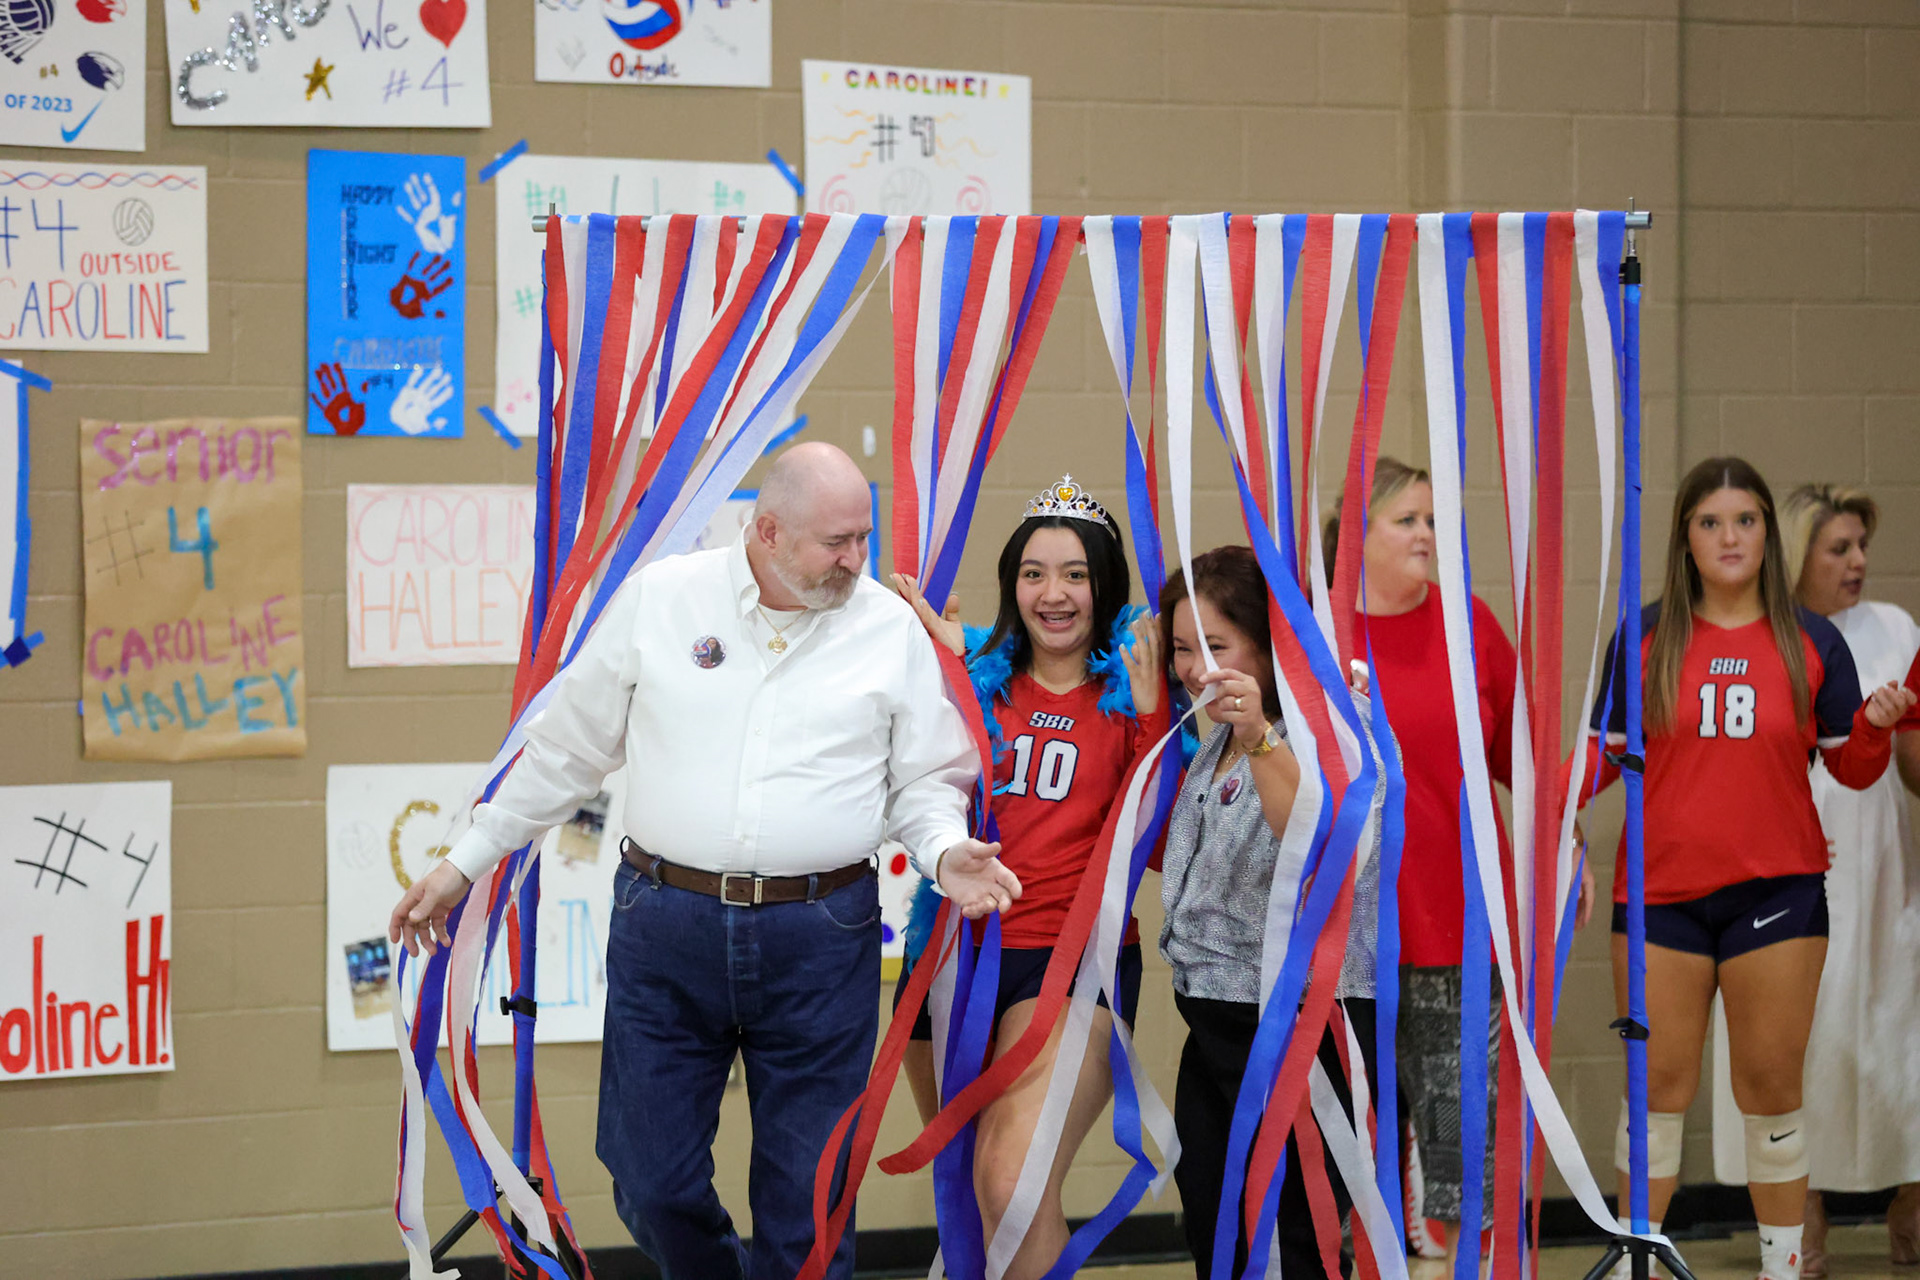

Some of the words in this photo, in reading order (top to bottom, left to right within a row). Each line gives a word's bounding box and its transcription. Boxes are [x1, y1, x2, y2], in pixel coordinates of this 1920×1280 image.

[347, 0, 408, 51] We
[4, 94, 27, 109] OF
[31, 95, 73, 113] 2023
[382, 55, 464, 106] #4
[845, 69, 989, 97] CAROLINE!
[80, 251, 181, 278] OUTSIDE
[355, 493, 536, 567] CAROLIN
[358, 565, 535, 653] HALLEY
[1708, 657, 1750, 676] SBA
[101, 667, 299, 737] HALLEY
[1028, 710, 1076, 732] SBA
[1698, 682, 1757, 740] 18
[1006, 733, 1080, 802] 10
